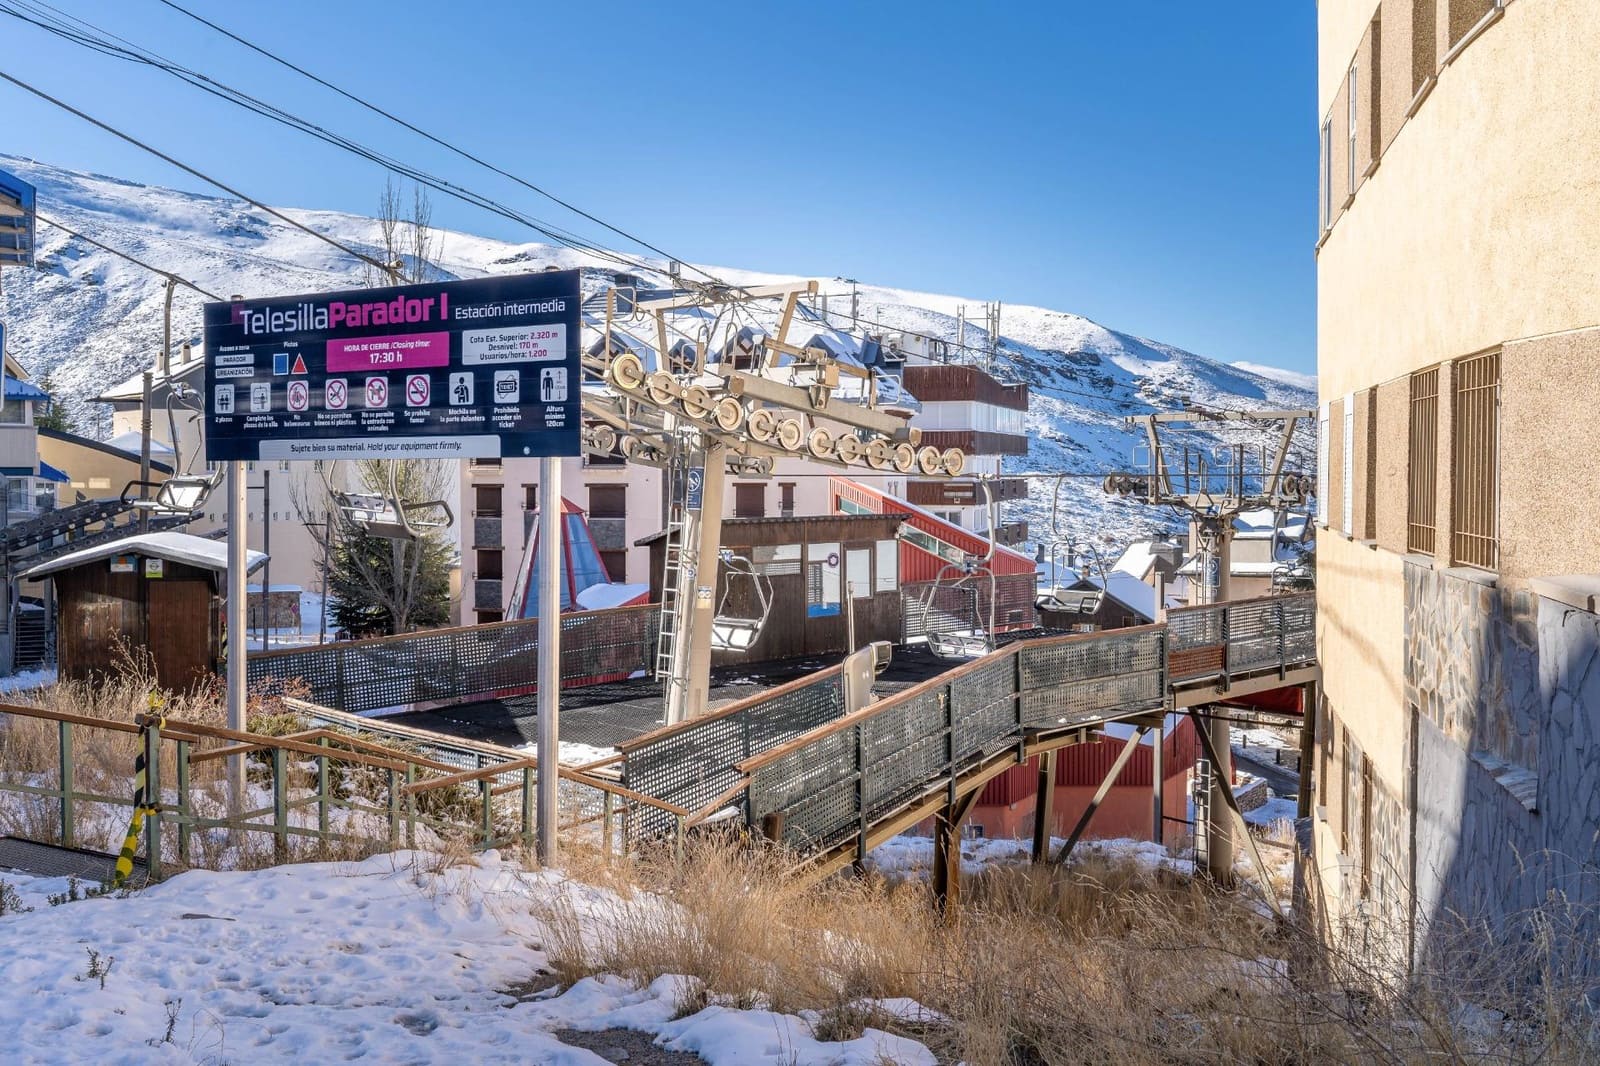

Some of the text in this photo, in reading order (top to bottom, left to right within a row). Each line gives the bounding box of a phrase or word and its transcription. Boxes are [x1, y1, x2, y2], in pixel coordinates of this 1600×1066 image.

[455, 299, 565, 320] Estación intermedia
[470, 336, 484, 344] Cota
[500, 333, 529, 343] Superior:
[530, 331, 550, 340] 2.320
[343, 344, 360, 352] HORA
[369, 342, 390, 351] CIERRE
[488, 343, 518, 351] Desnivel:
[528, 349, 547, 357] 1.200
[369, 351, 403, 364] 17:30 h
[216, 368, 253, 377] URBANIZACIÓN
[493, 406, 520, 414] Prohibido
[375, 411, 395, 419] permite
[498, 420, 515, 428] ticket
[545, 419, 564, 427] 120cm
[290, 444, 311, 453] Sujete
[312, 443, 326, 451] bien
[336, 442, 365, 451] material.
[367, 442, 383, 451] Hold
[383, 443, 399, 452] your
[400, 441, 438, 452] equipment
[438, 440, 462, 450] firmly.
